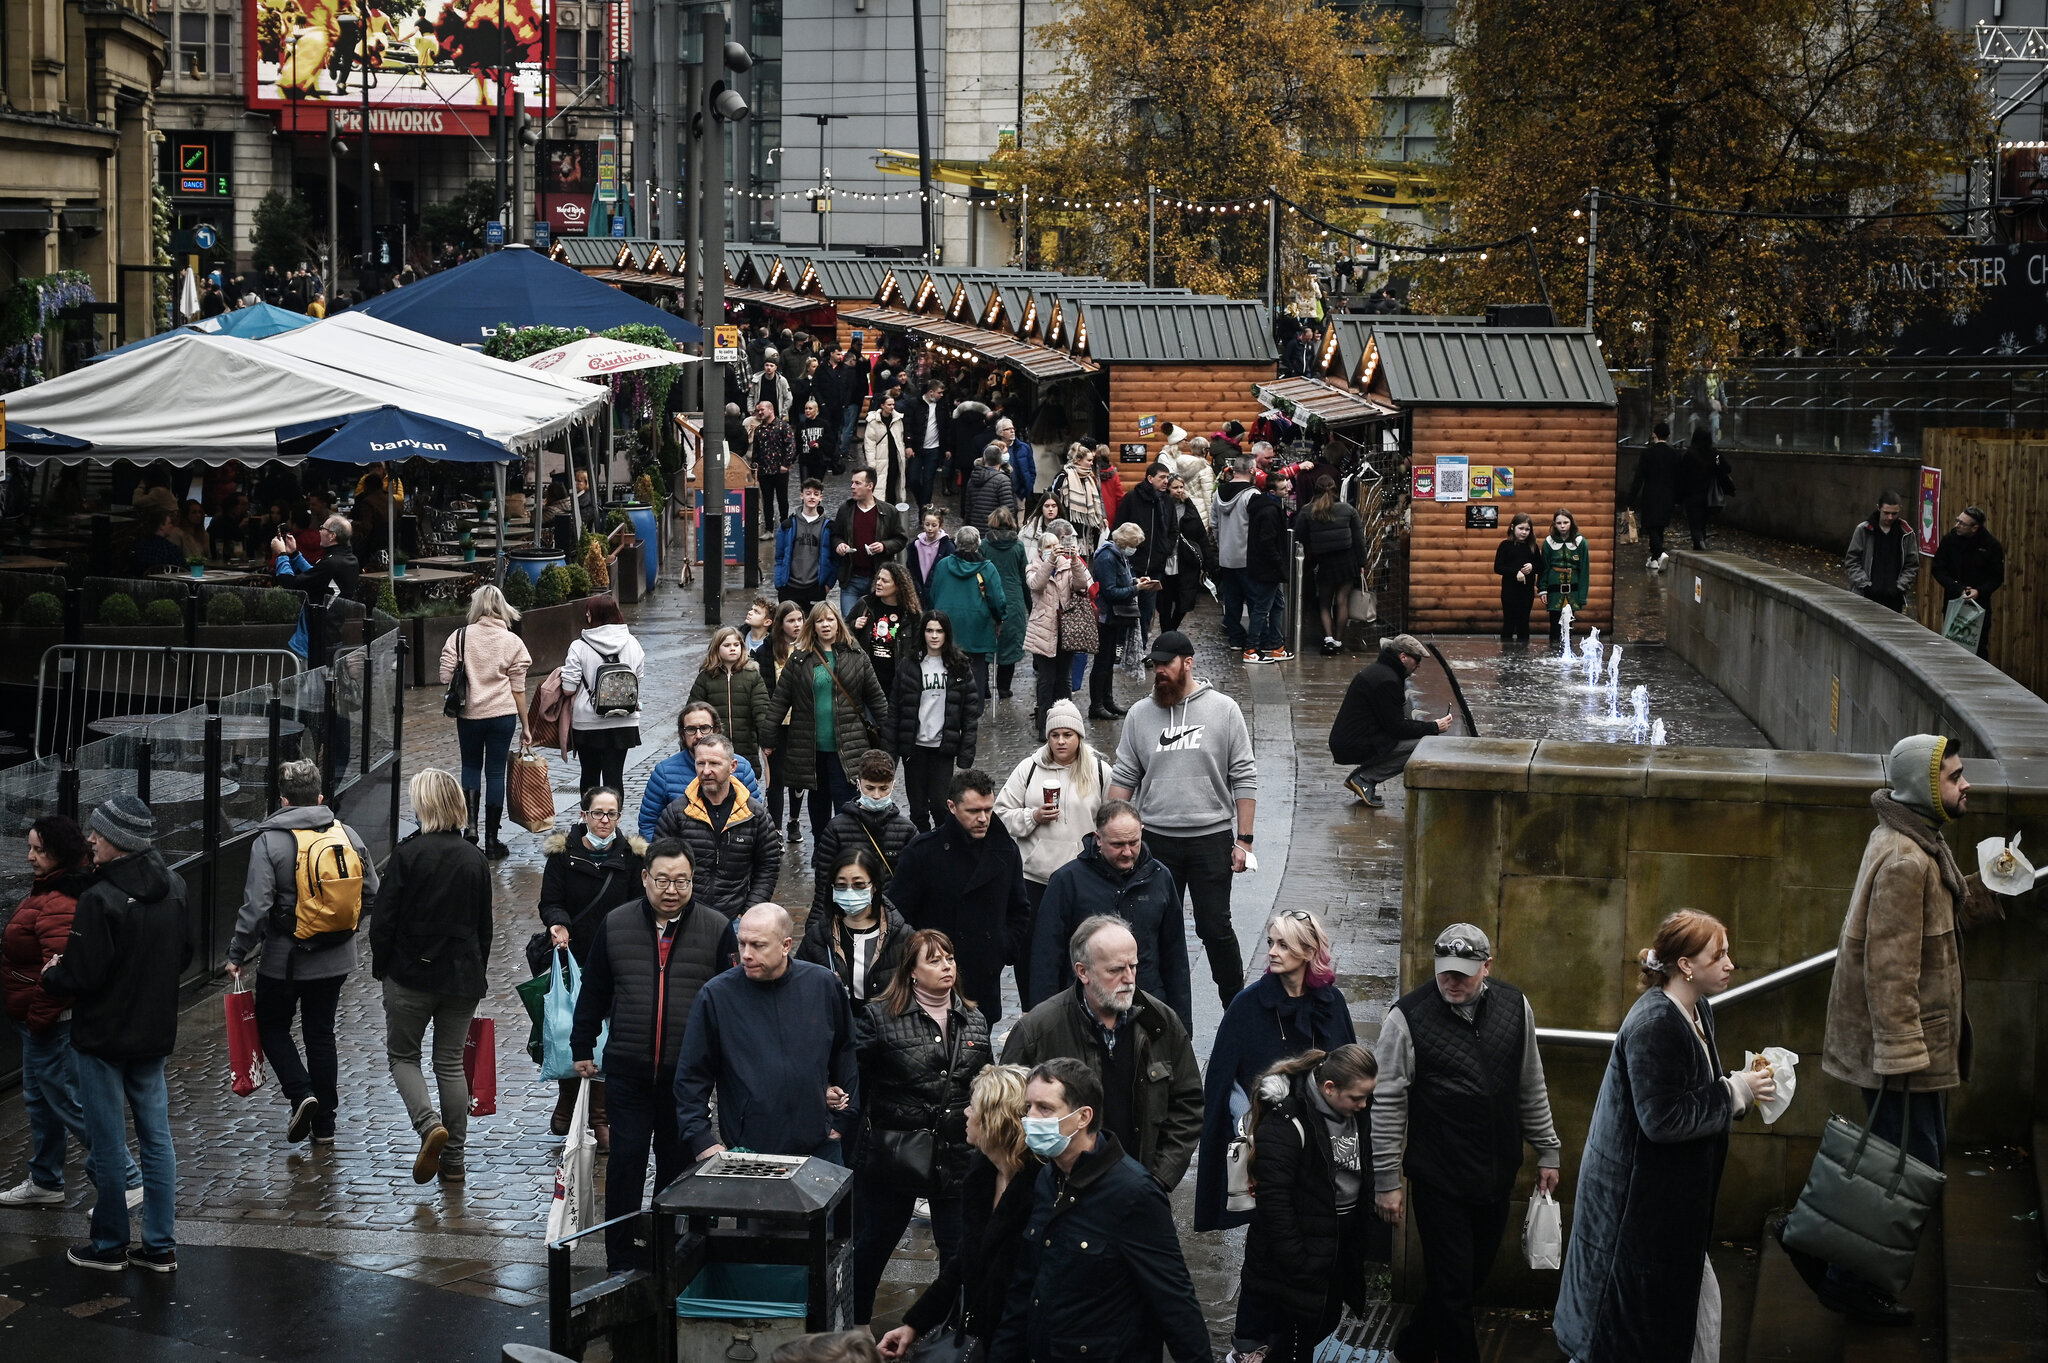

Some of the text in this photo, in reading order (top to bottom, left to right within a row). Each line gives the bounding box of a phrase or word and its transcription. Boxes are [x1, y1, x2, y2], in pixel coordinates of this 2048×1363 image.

[339, 108, 443, 132] PRNTWORKS
[571, 206, 585, 215] Rock
[588, 352, 656, 372] Budvar
[370, 438, 447, 452] banyan
[1474, 478, 1488, 486] FACE
[1156, 724, 1206, 753] NIKE
